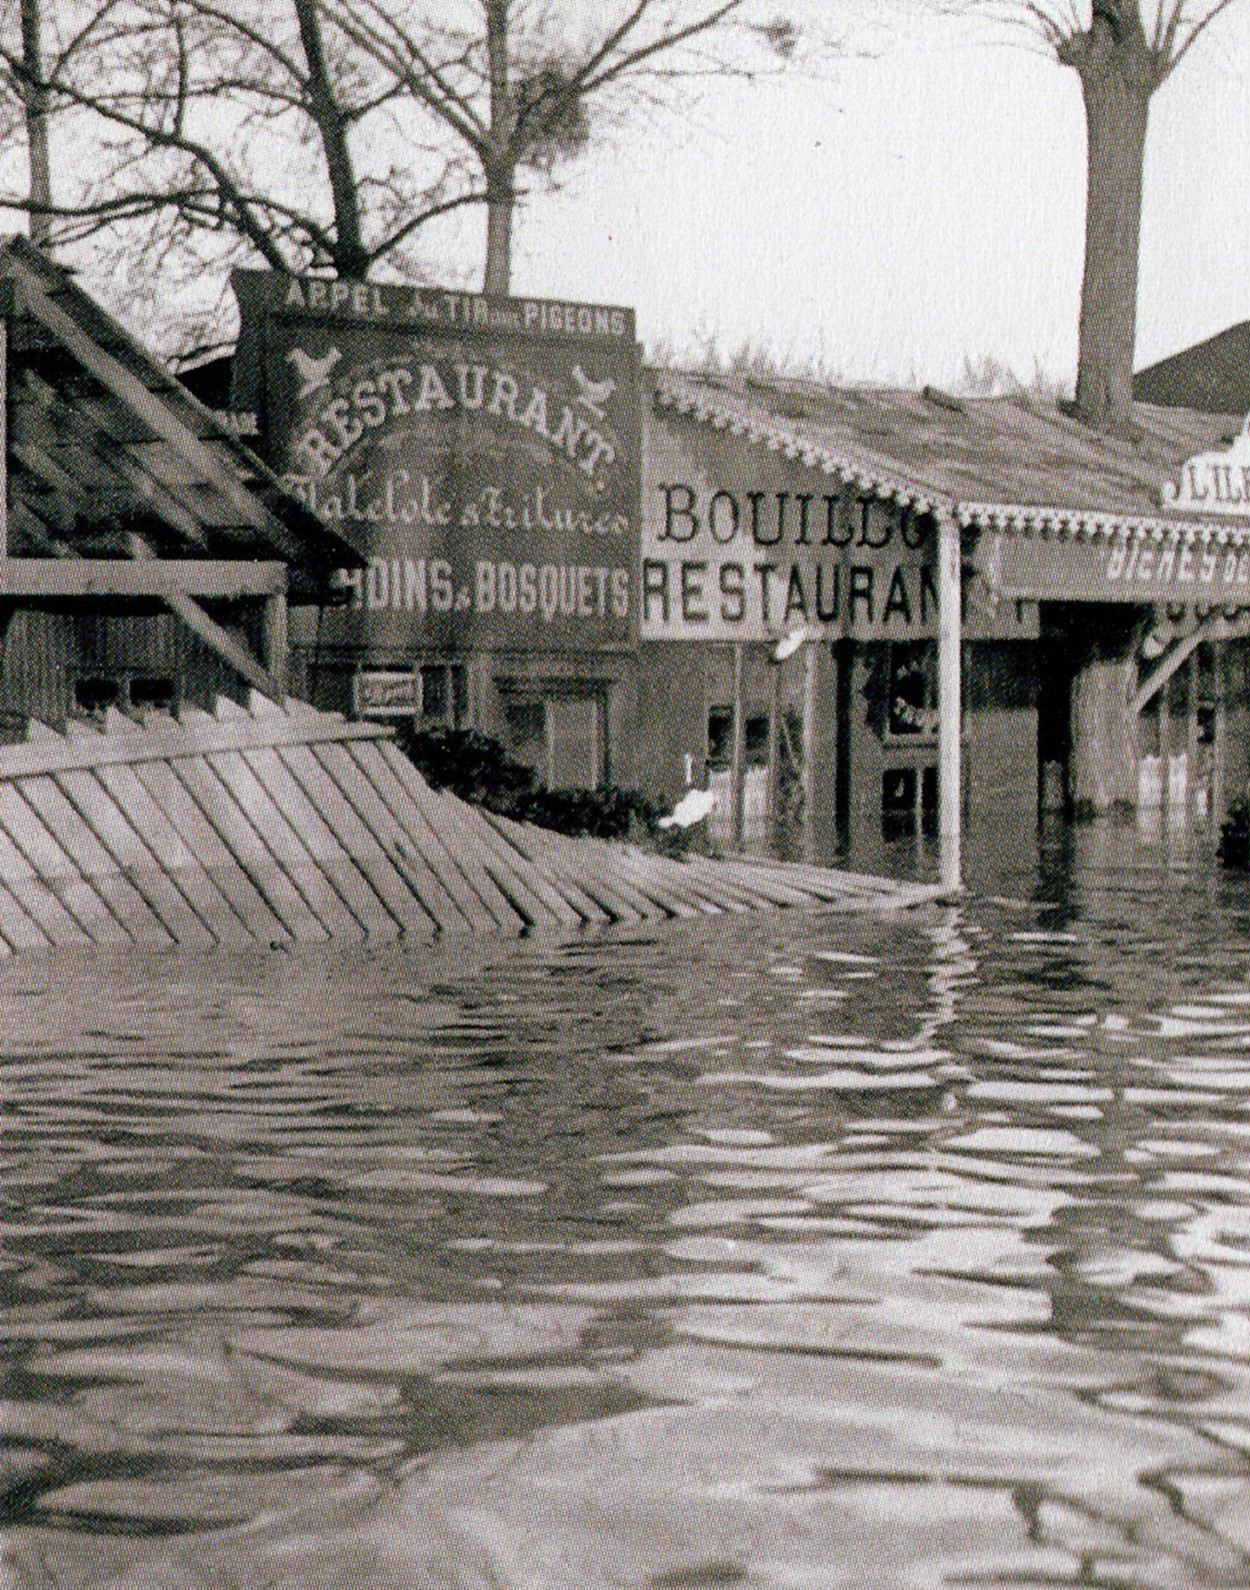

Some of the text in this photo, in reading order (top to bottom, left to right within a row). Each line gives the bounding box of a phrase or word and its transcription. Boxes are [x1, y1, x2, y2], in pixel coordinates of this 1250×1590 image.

[444, 293, 489, 326] TIR
[523, 299, 626, 336] PIGEONS
[474, 560, 630, 624] BOSQUETS
